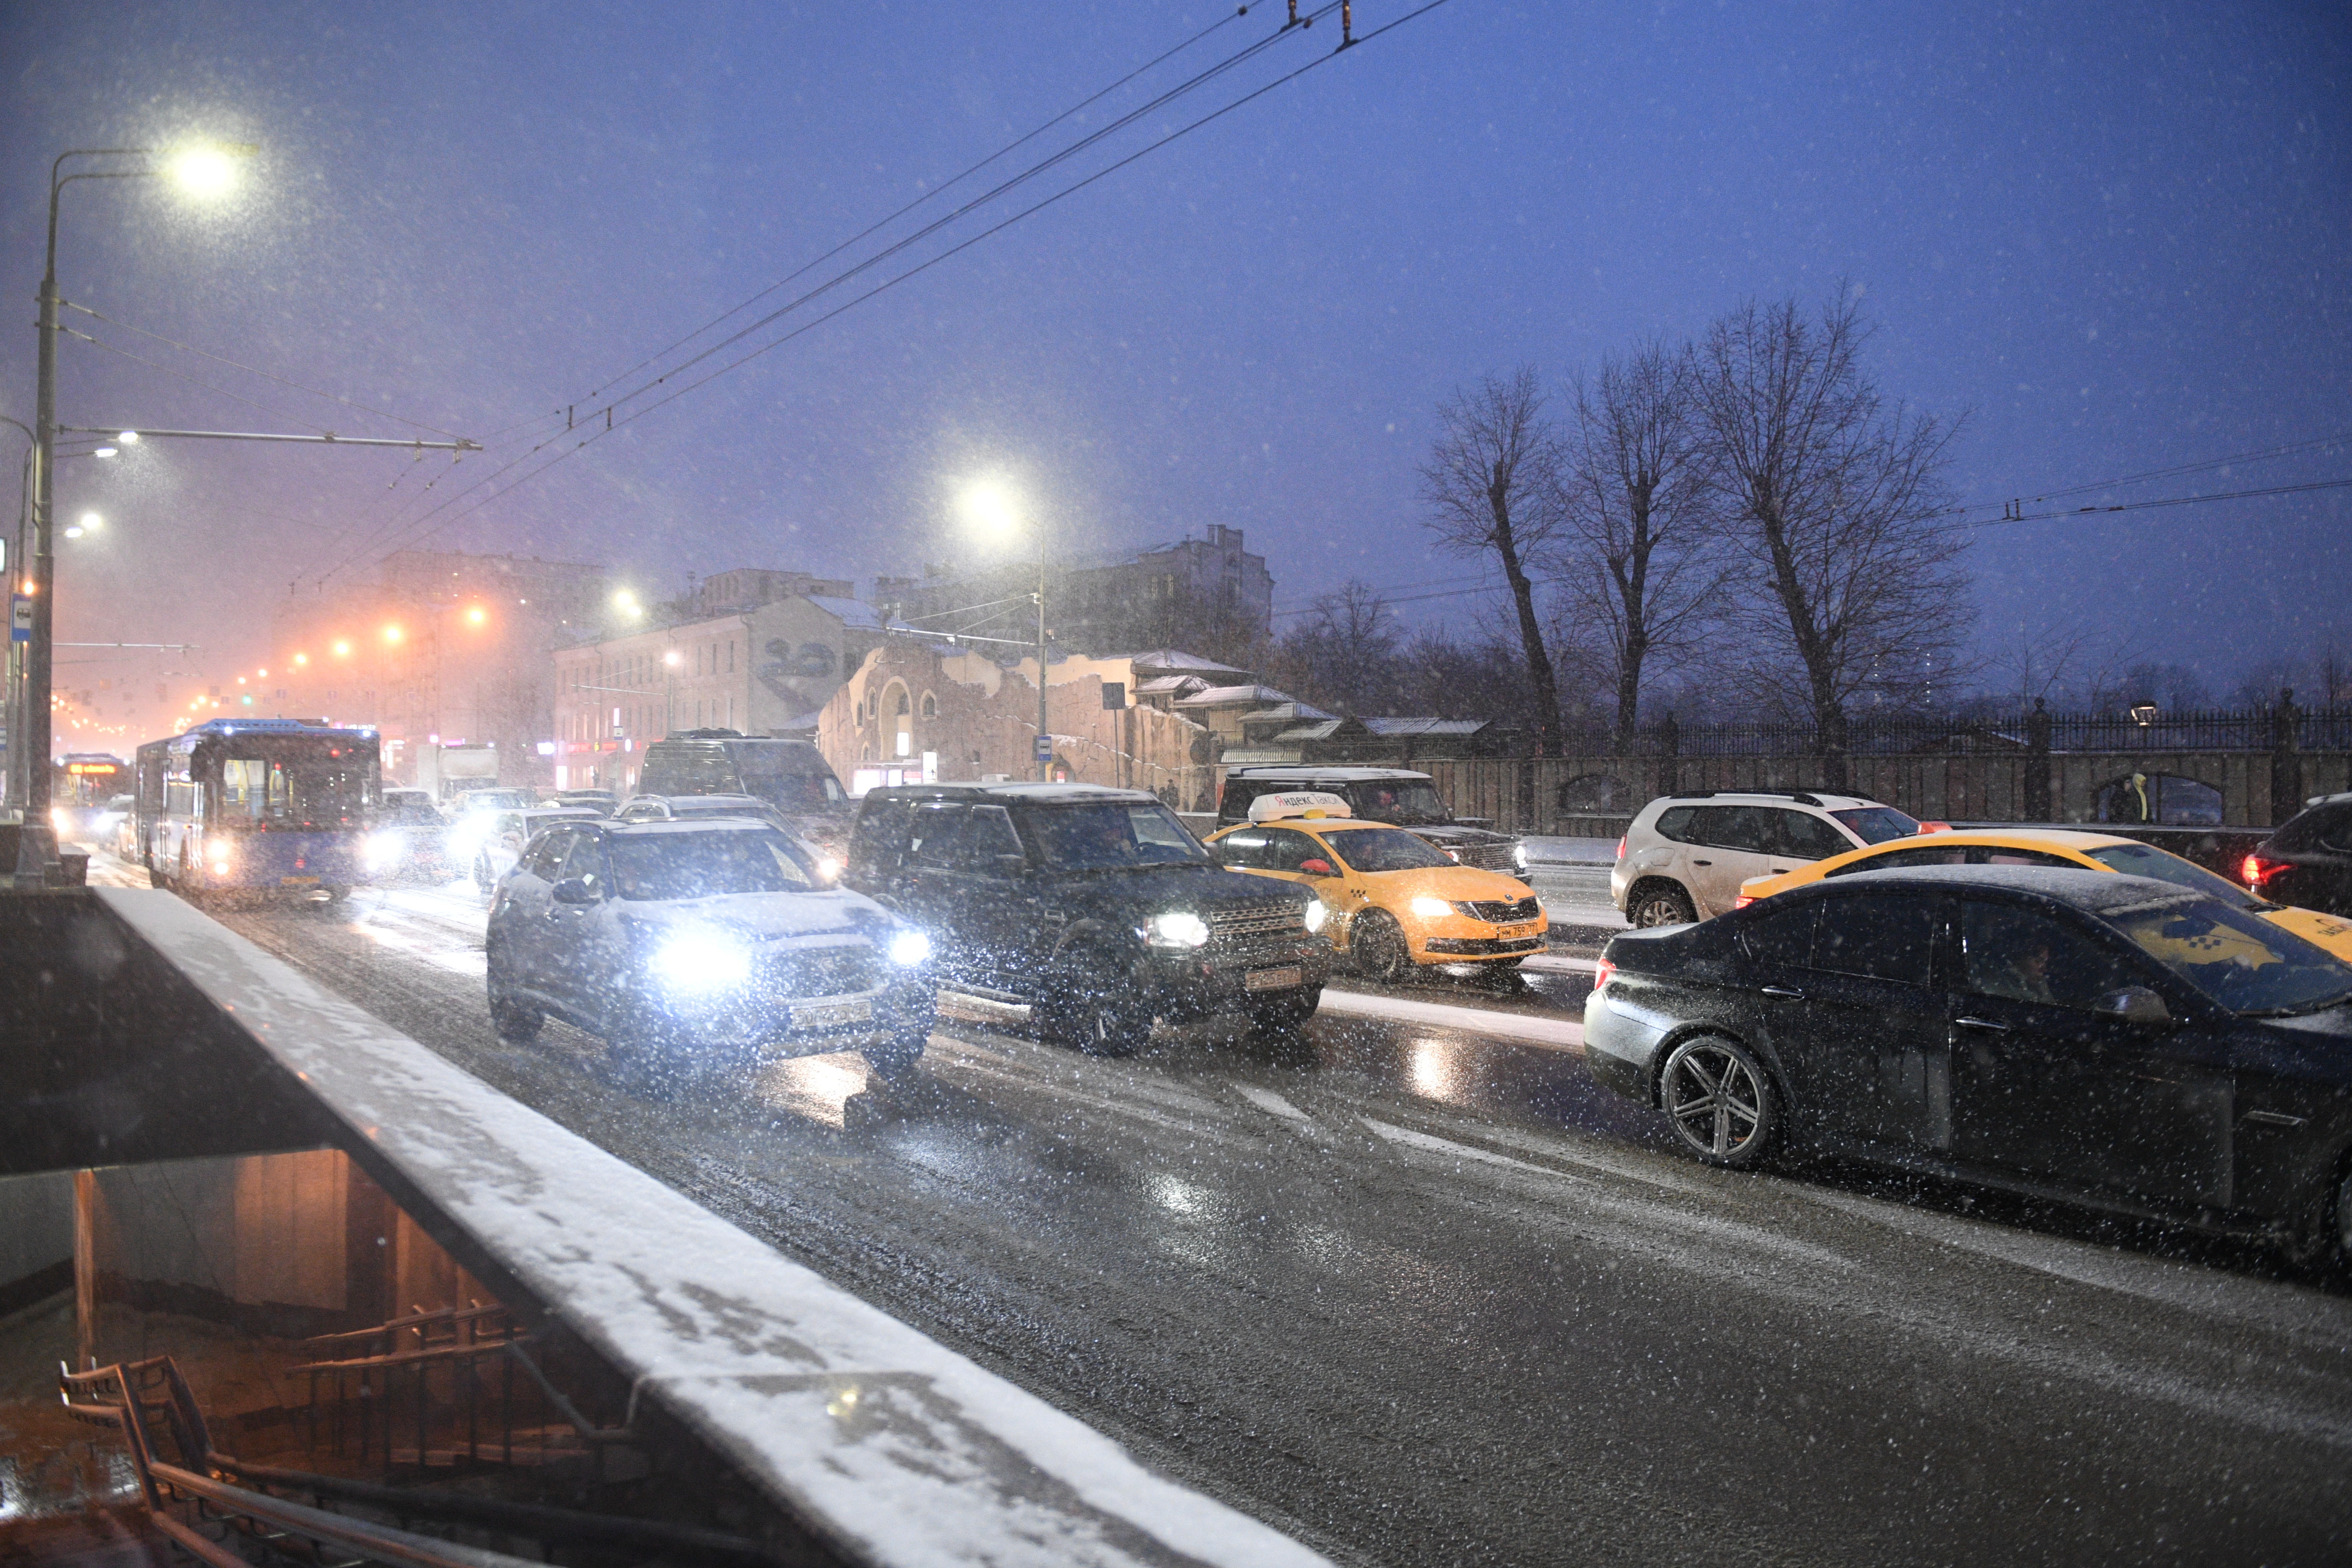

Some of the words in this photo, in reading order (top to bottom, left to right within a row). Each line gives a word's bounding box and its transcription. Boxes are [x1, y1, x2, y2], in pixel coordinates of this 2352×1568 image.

[1275, 795, 1314, 807] Яндекс
[1310, 794, 1340, 804] Такси
[1513, 926, 1525, 936] 759
